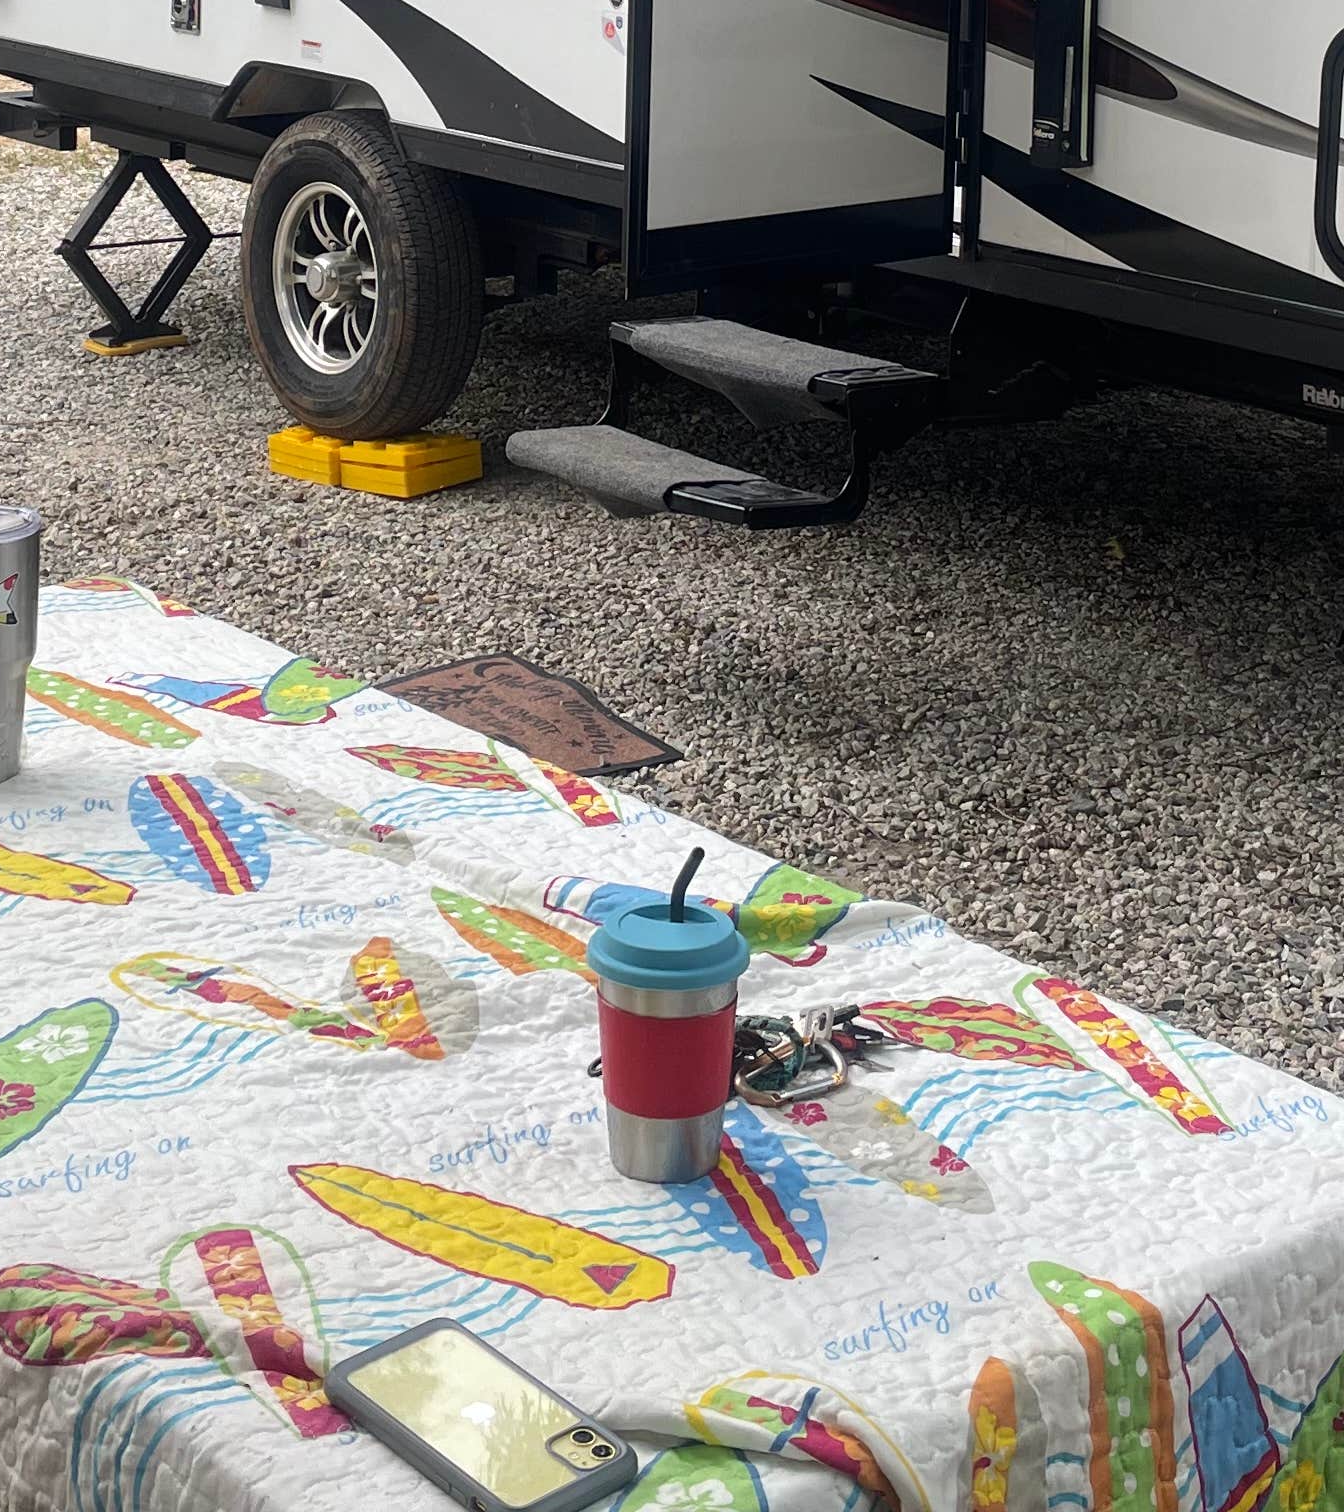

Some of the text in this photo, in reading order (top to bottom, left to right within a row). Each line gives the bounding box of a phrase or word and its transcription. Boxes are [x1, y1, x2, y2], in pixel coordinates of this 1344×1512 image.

[157, 1135, 191, 1155] on
[429, 1106, 602, 1173] surfing on
[1218, 1095, 1328, 1141] surfing
[823, 1280, 1011, 1361] surfing on
